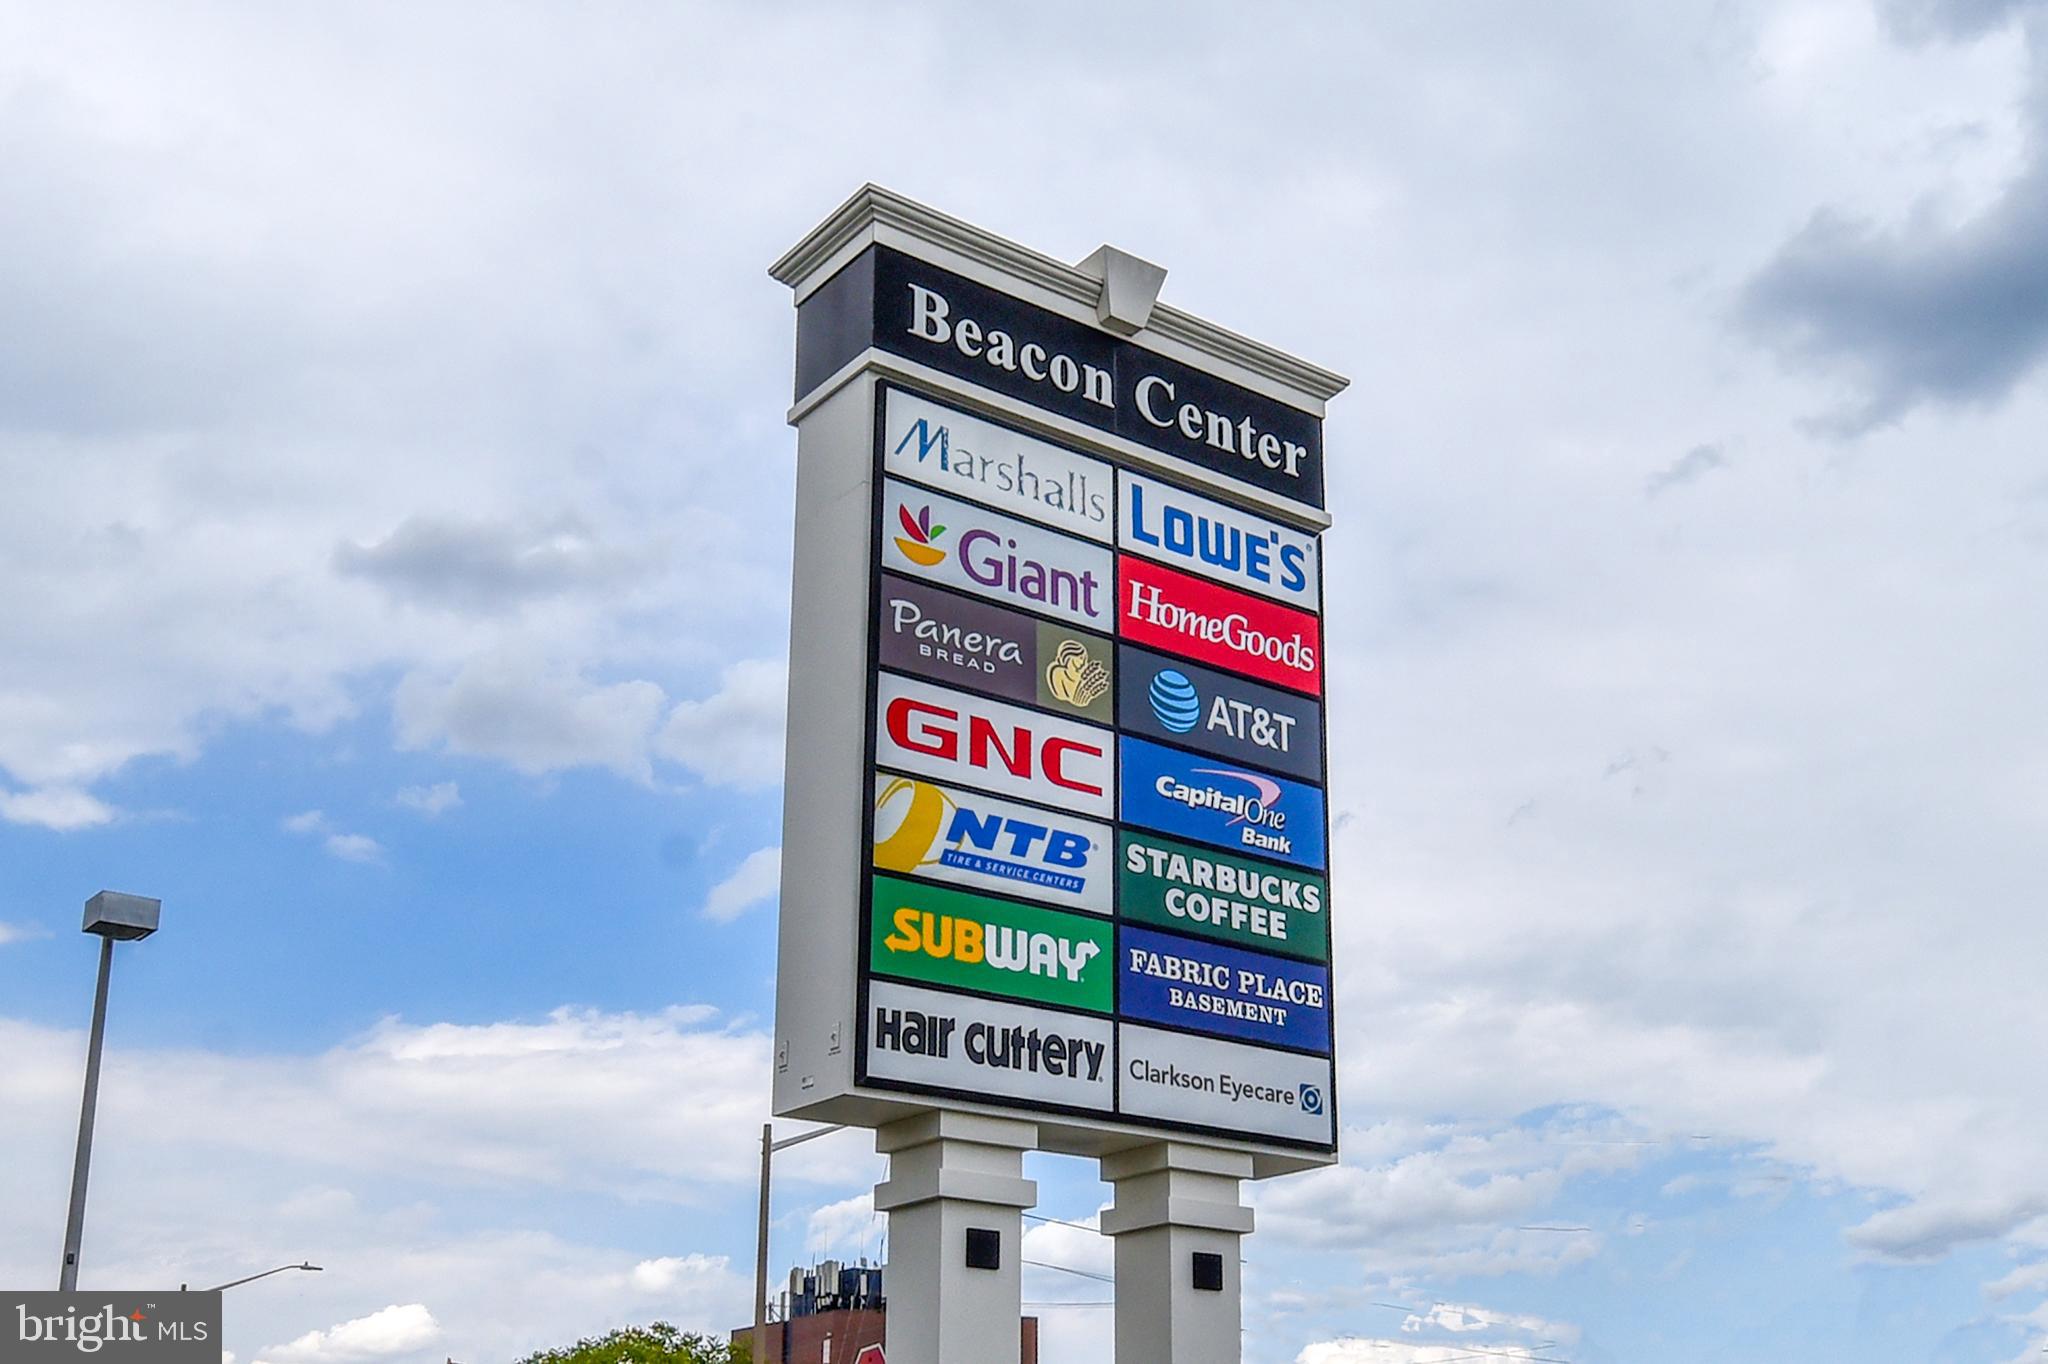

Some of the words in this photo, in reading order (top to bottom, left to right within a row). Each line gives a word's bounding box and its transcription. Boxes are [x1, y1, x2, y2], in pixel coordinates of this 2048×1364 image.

[907, 282, 1116, 408] Beacon
[1135, 375, 1307, 478] Center
[894, 417, 1106, 522] Marshalls
[1131, 483, 1306, 592] LOWE'S
[958, 528, 1099, 618] Giant
[889, 599, 1023, 666] Panera
[1127, 579, 1315, 672] HomeGoods
[919, 645, 997, 675] BREAD
[886, 696, 1103, 797] GNC
[1207, 695, 1297, 753] AT&T
[946, 807, 1091, 869] NTB
[1241, 827, 1291, 854] Bank
[946, 853, 973, 868] TIRE
[974, 860, 982, 869] &
[986, 861, 1030, 880] SERVICE
[1032, 871, 1080, 890] CENTERS
[1126, 843, 1321, 913] STARBUCKS
[884, 908, 1101, 982] SUBWAY
[1165, 888, 1287, 940] COFFEE
[1129, 948, 1230, 991] FABRIC
[1237, 970, 1323, 1009] PLACE
[1168, 988, 1287, 1027] BASEMENT
[875, 1007, 955, 1059] Hair
[1129, 1059, 1215, 1093] Clarkson
[1219, 1075, 1295, 1106] Eyecare
